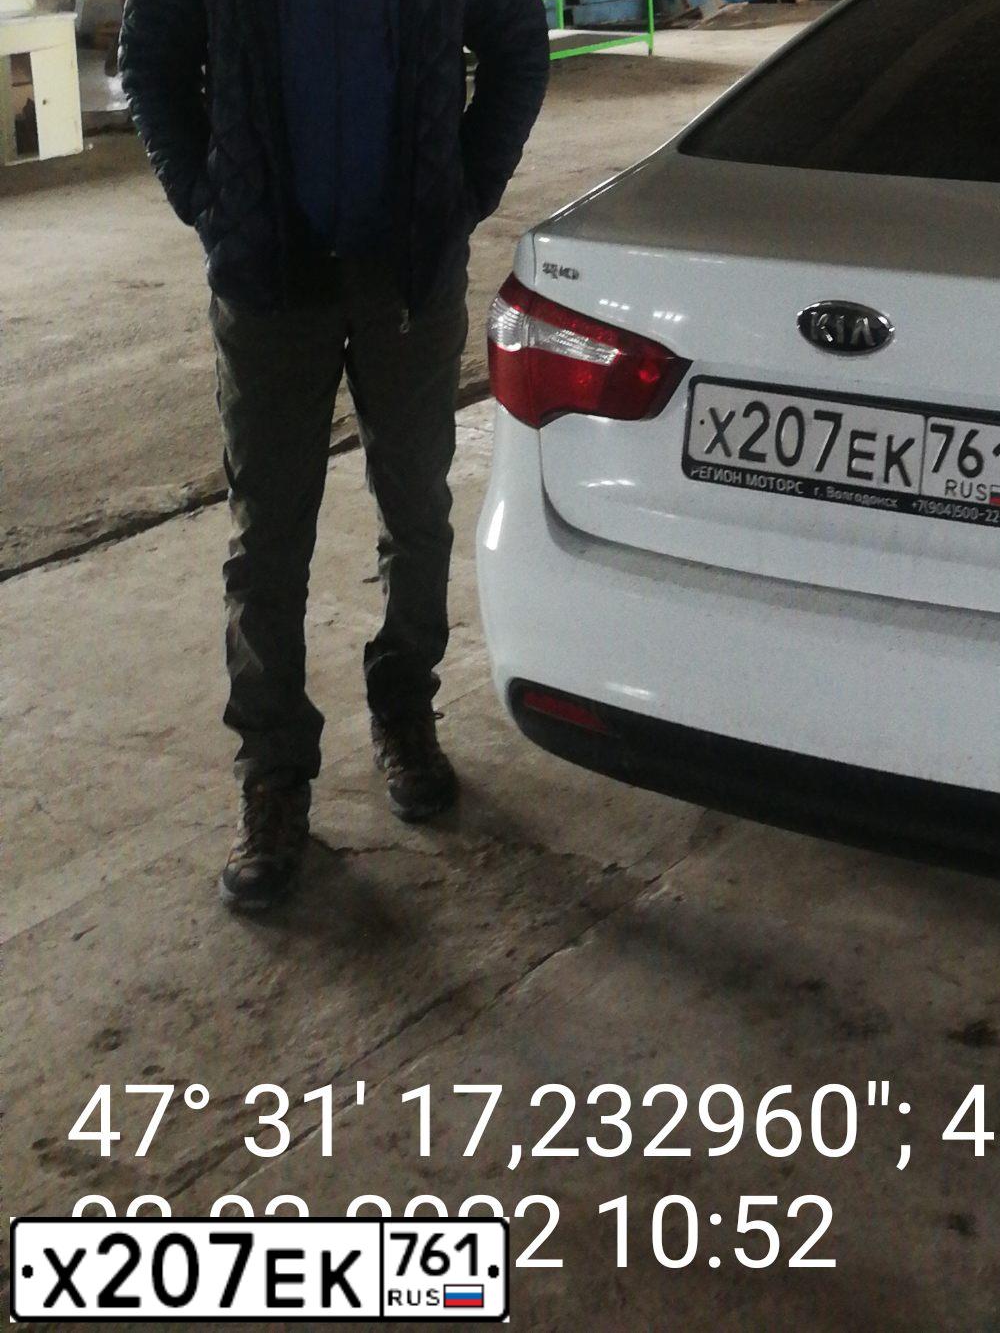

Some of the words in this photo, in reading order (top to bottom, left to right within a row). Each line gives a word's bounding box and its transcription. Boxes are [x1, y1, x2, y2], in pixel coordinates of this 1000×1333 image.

[809, 311, 876, 347] KIA
[704, 400, 917, 487] Х207ЕК
[745, 472, 804, 495] МОТОРС
[944, 478, 988, 501] RUS
